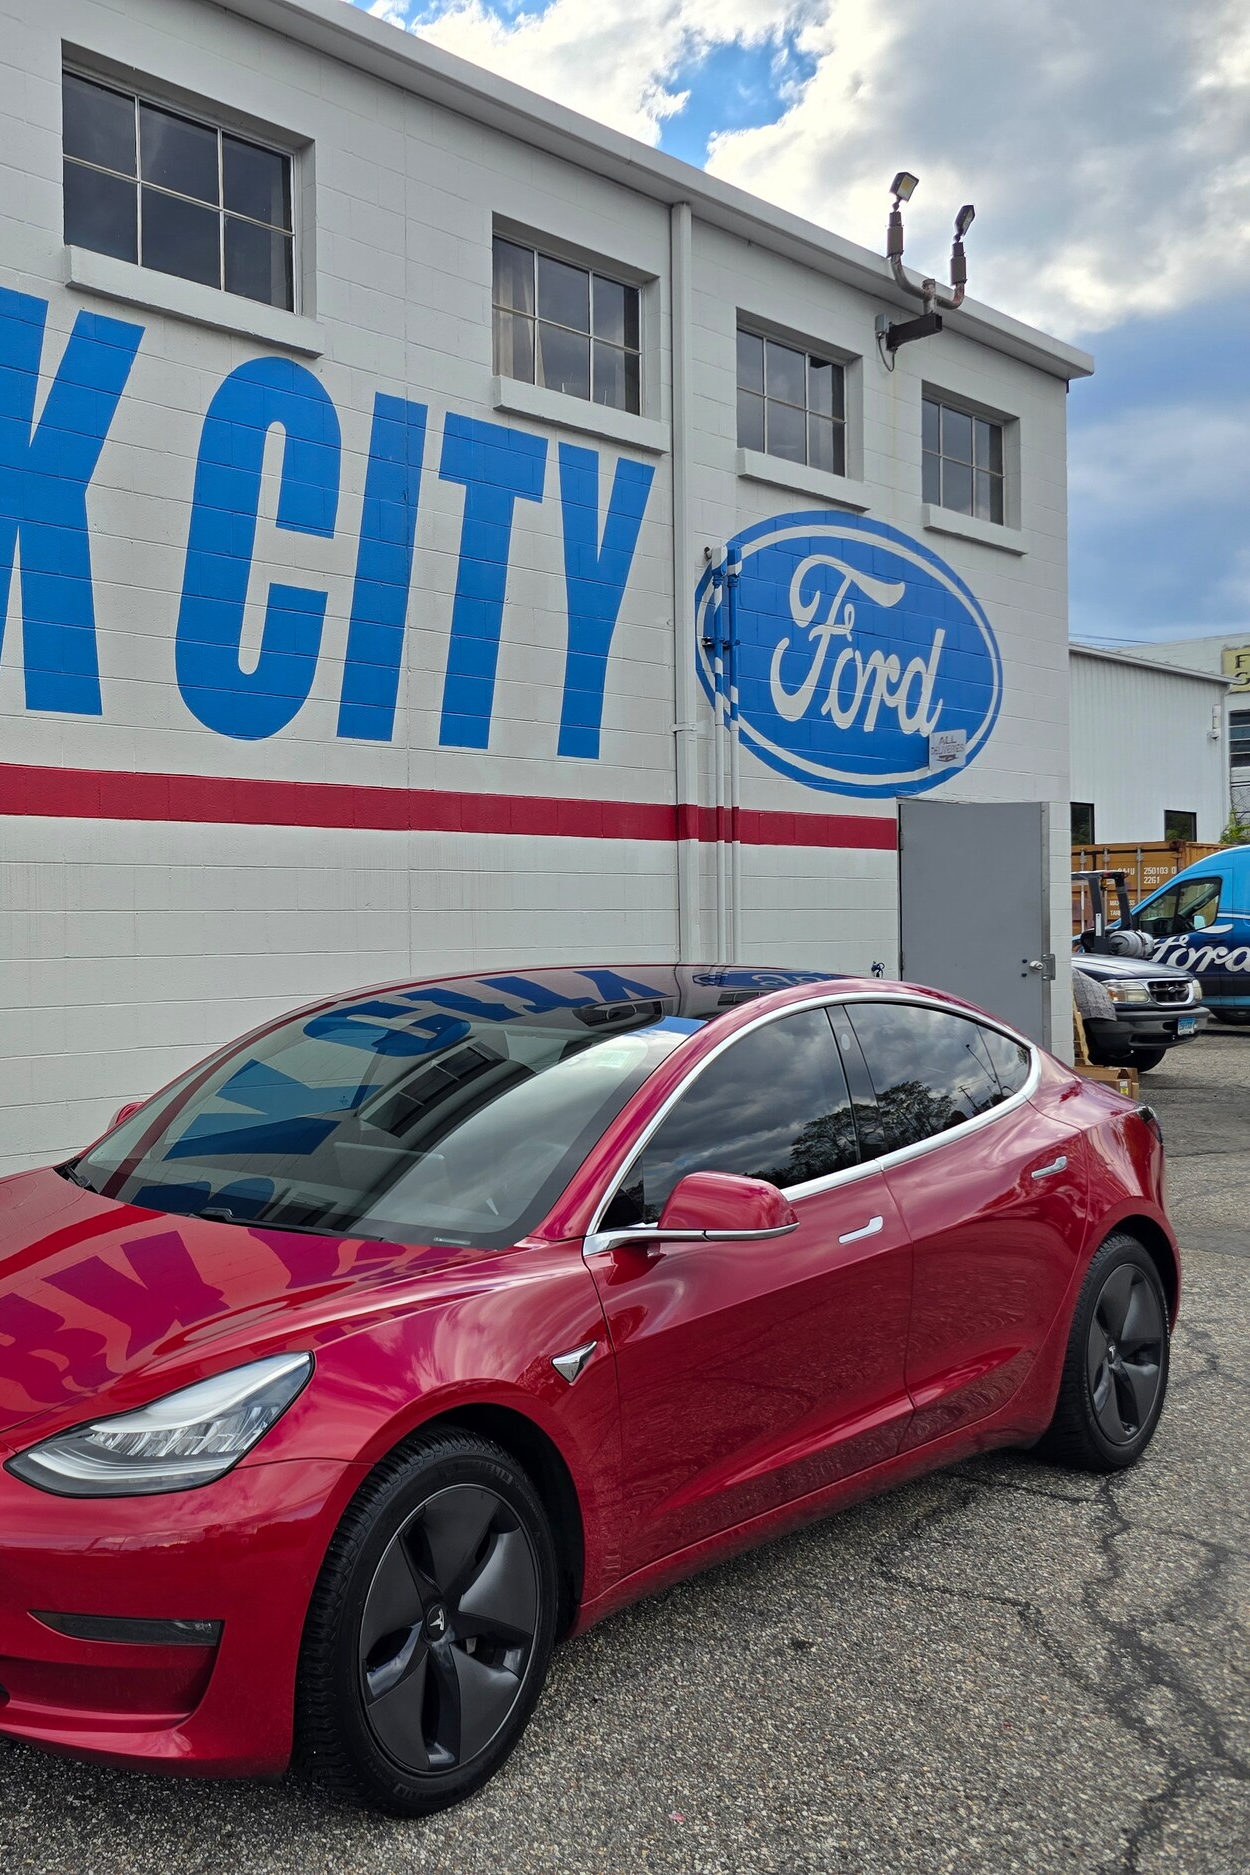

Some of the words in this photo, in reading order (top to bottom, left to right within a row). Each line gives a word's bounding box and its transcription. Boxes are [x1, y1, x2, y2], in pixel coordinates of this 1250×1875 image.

[175, 356, 655, 760] CITY
[770, 554, 944, 737] Ford
[938, 735, 957, 745] ALL
[931, 743, 965, 756] DELIVERIES
[1143, 866, 1169, 875] 250103
